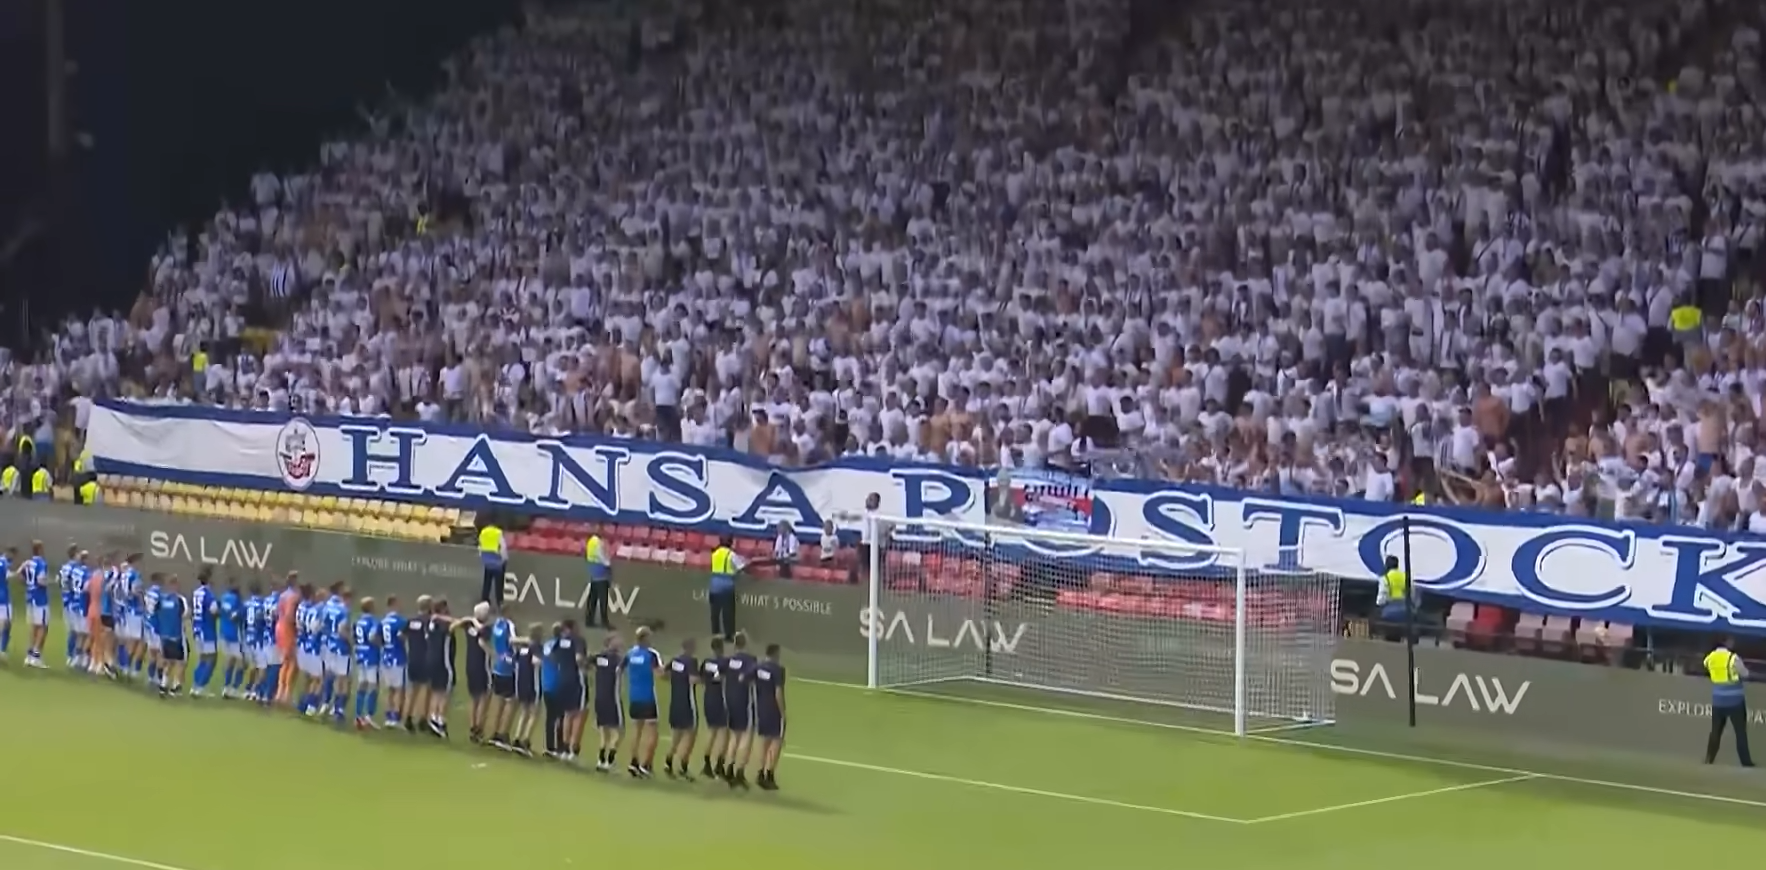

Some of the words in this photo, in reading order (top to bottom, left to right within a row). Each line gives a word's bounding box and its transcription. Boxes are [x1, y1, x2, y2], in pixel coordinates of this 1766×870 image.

[339, 424, 826, 532] HANSA
[150, 530, 193, 562] SA
[200, 535, 273, 570] LAW
[741, 592, 779, 609] WHATS
[783, 596, 832, 616] POSSIBLE
[859, 606, 915, 643] SA
[927, 614, 1026, 653] LAW
[1331, 658, 1397, 699] SA
[1414, 666, 1531, 714] LAW
[1658, 698, 1713, 717] EXPLOR
